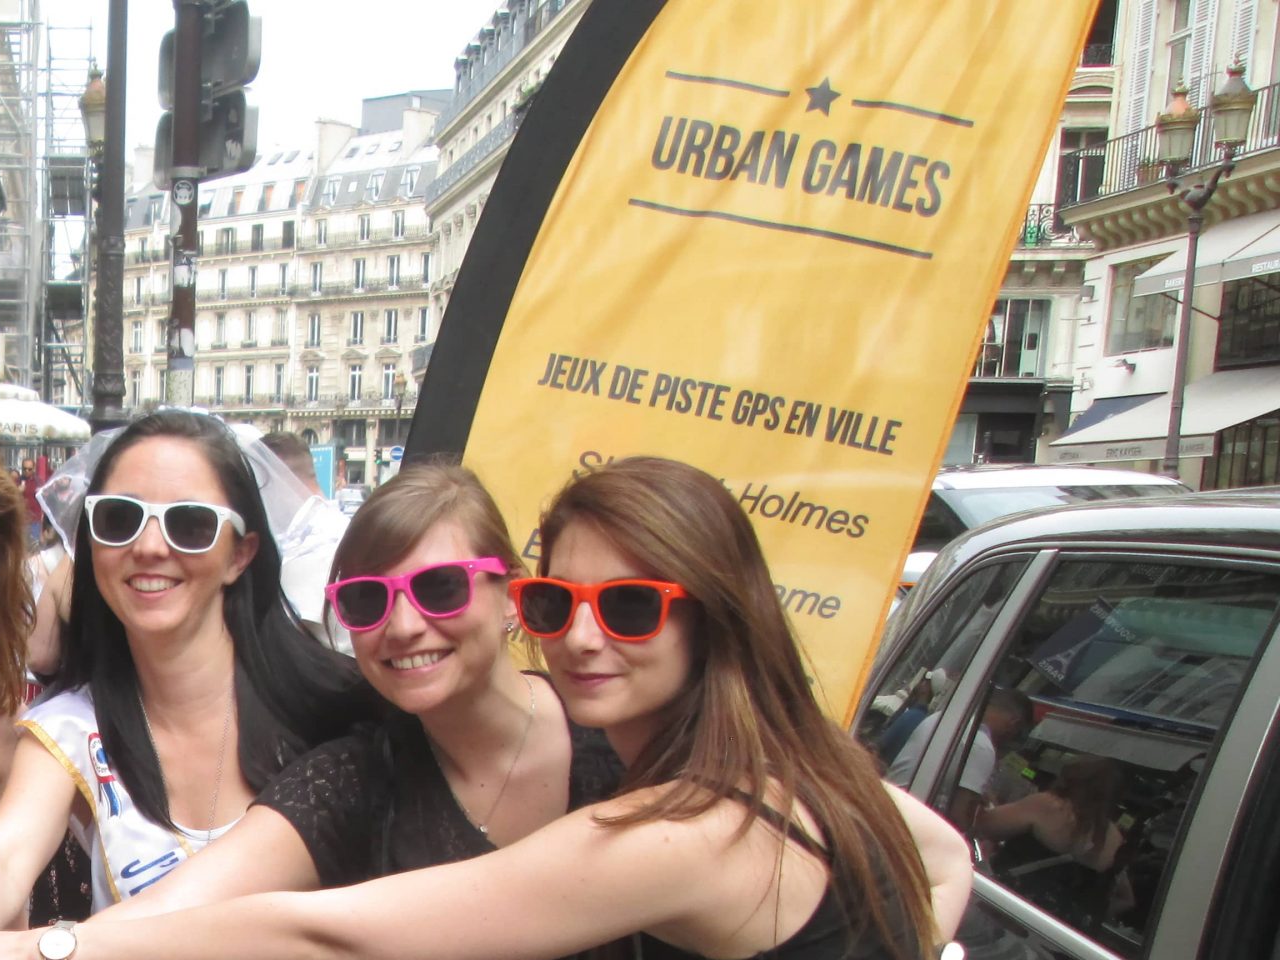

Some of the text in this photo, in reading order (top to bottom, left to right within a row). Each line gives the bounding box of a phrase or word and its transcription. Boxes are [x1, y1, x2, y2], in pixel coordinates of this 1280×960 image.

[651, 116, 950, 218] URBAN GAMES
[538, 353, 903, 456] JEUX DE PISTE GPS EN VILLE
[739, 482, 869, 538] Holmes
